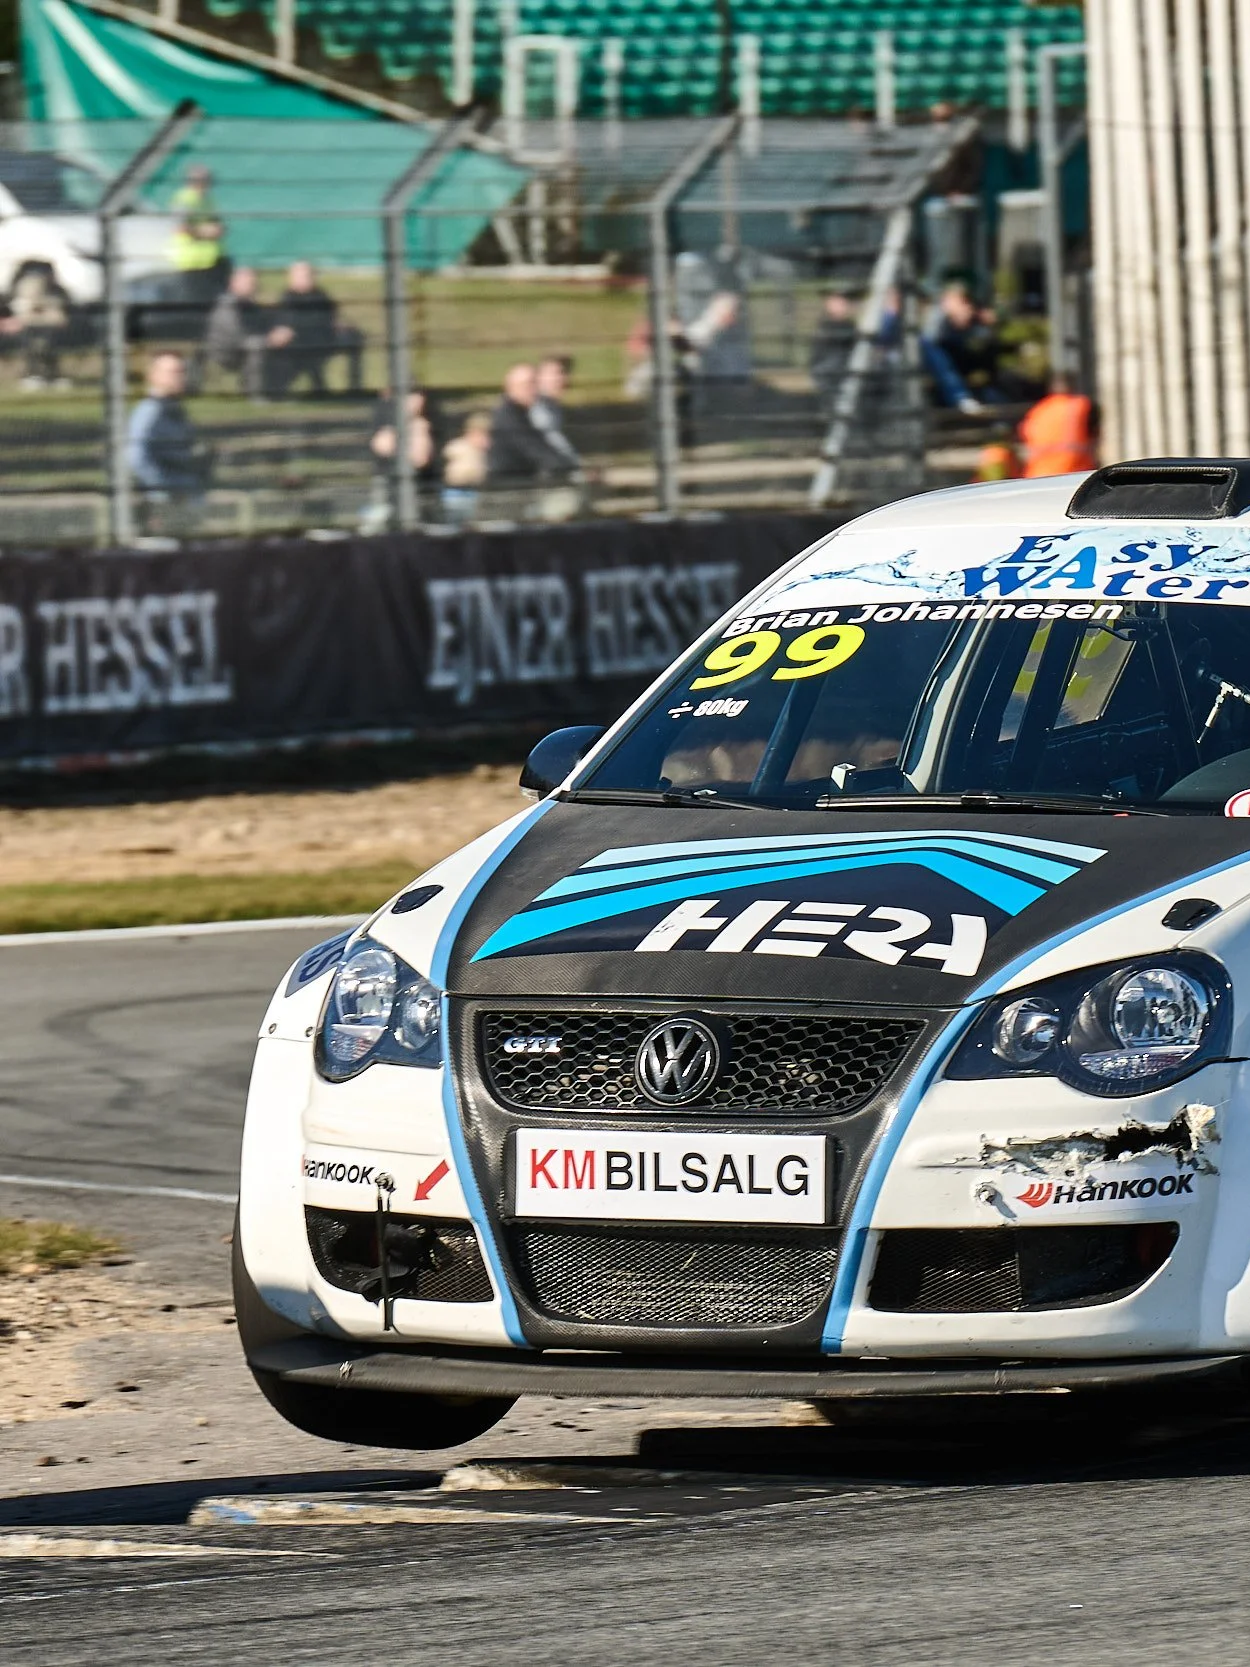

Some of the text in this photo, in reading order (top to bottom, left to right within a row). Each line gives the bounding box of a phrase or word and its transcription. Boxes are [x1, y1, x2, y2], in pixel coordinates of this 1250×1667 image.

[36, 590, 233, 714] HESSEL
[583, 563, 740, 676] HESSE
[721, 602, 1124, 639] Brian Johannesen
[689, 624, 866, 690] 99
[693, 698, 750, 718] 80kg
[634, 900, 988, 977] HERA
[503, 1036, 562, 1053] GTI
